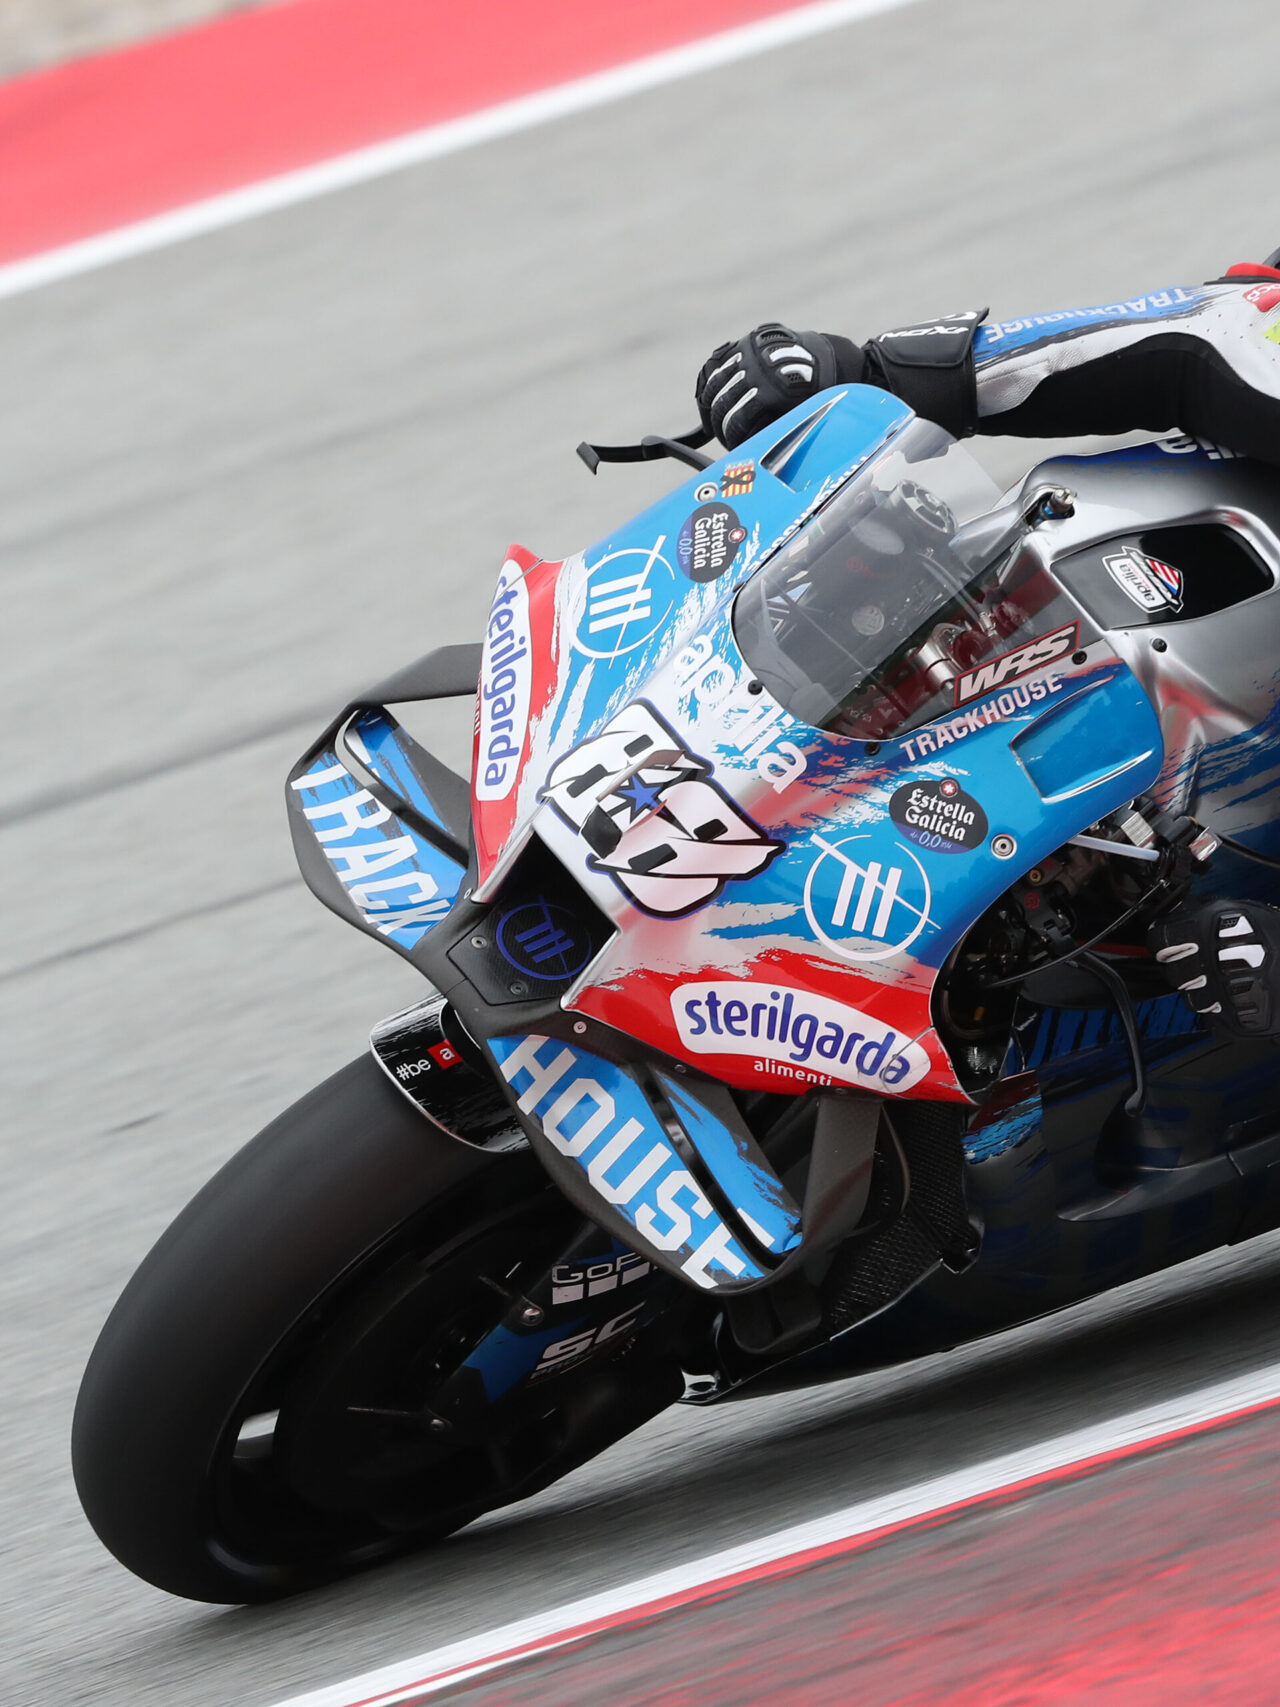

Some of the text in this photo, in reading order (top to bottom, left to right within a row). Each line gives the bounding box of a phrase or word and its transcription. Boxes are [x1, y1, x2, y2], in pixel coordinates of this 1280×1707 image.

[694, 517, 711, 569] Galicia
[711, 513, 728, 568] Estrella
[959, 626, 1075, 702] WRS
[899, 673, 1063, 762] TRACKHOUSE
[905, 806, 966, 841] Galicia
[907, 788, 975, 825] Estrella
[685, 991, 911, 1085] sterilgarda
[396, 1059, 431, 1081] #be
[753, 1058, 833, 1087] alimenti
[501, 1035, 775, 1288] HOUSE
[552, 1251, 642, 1284] GoP
